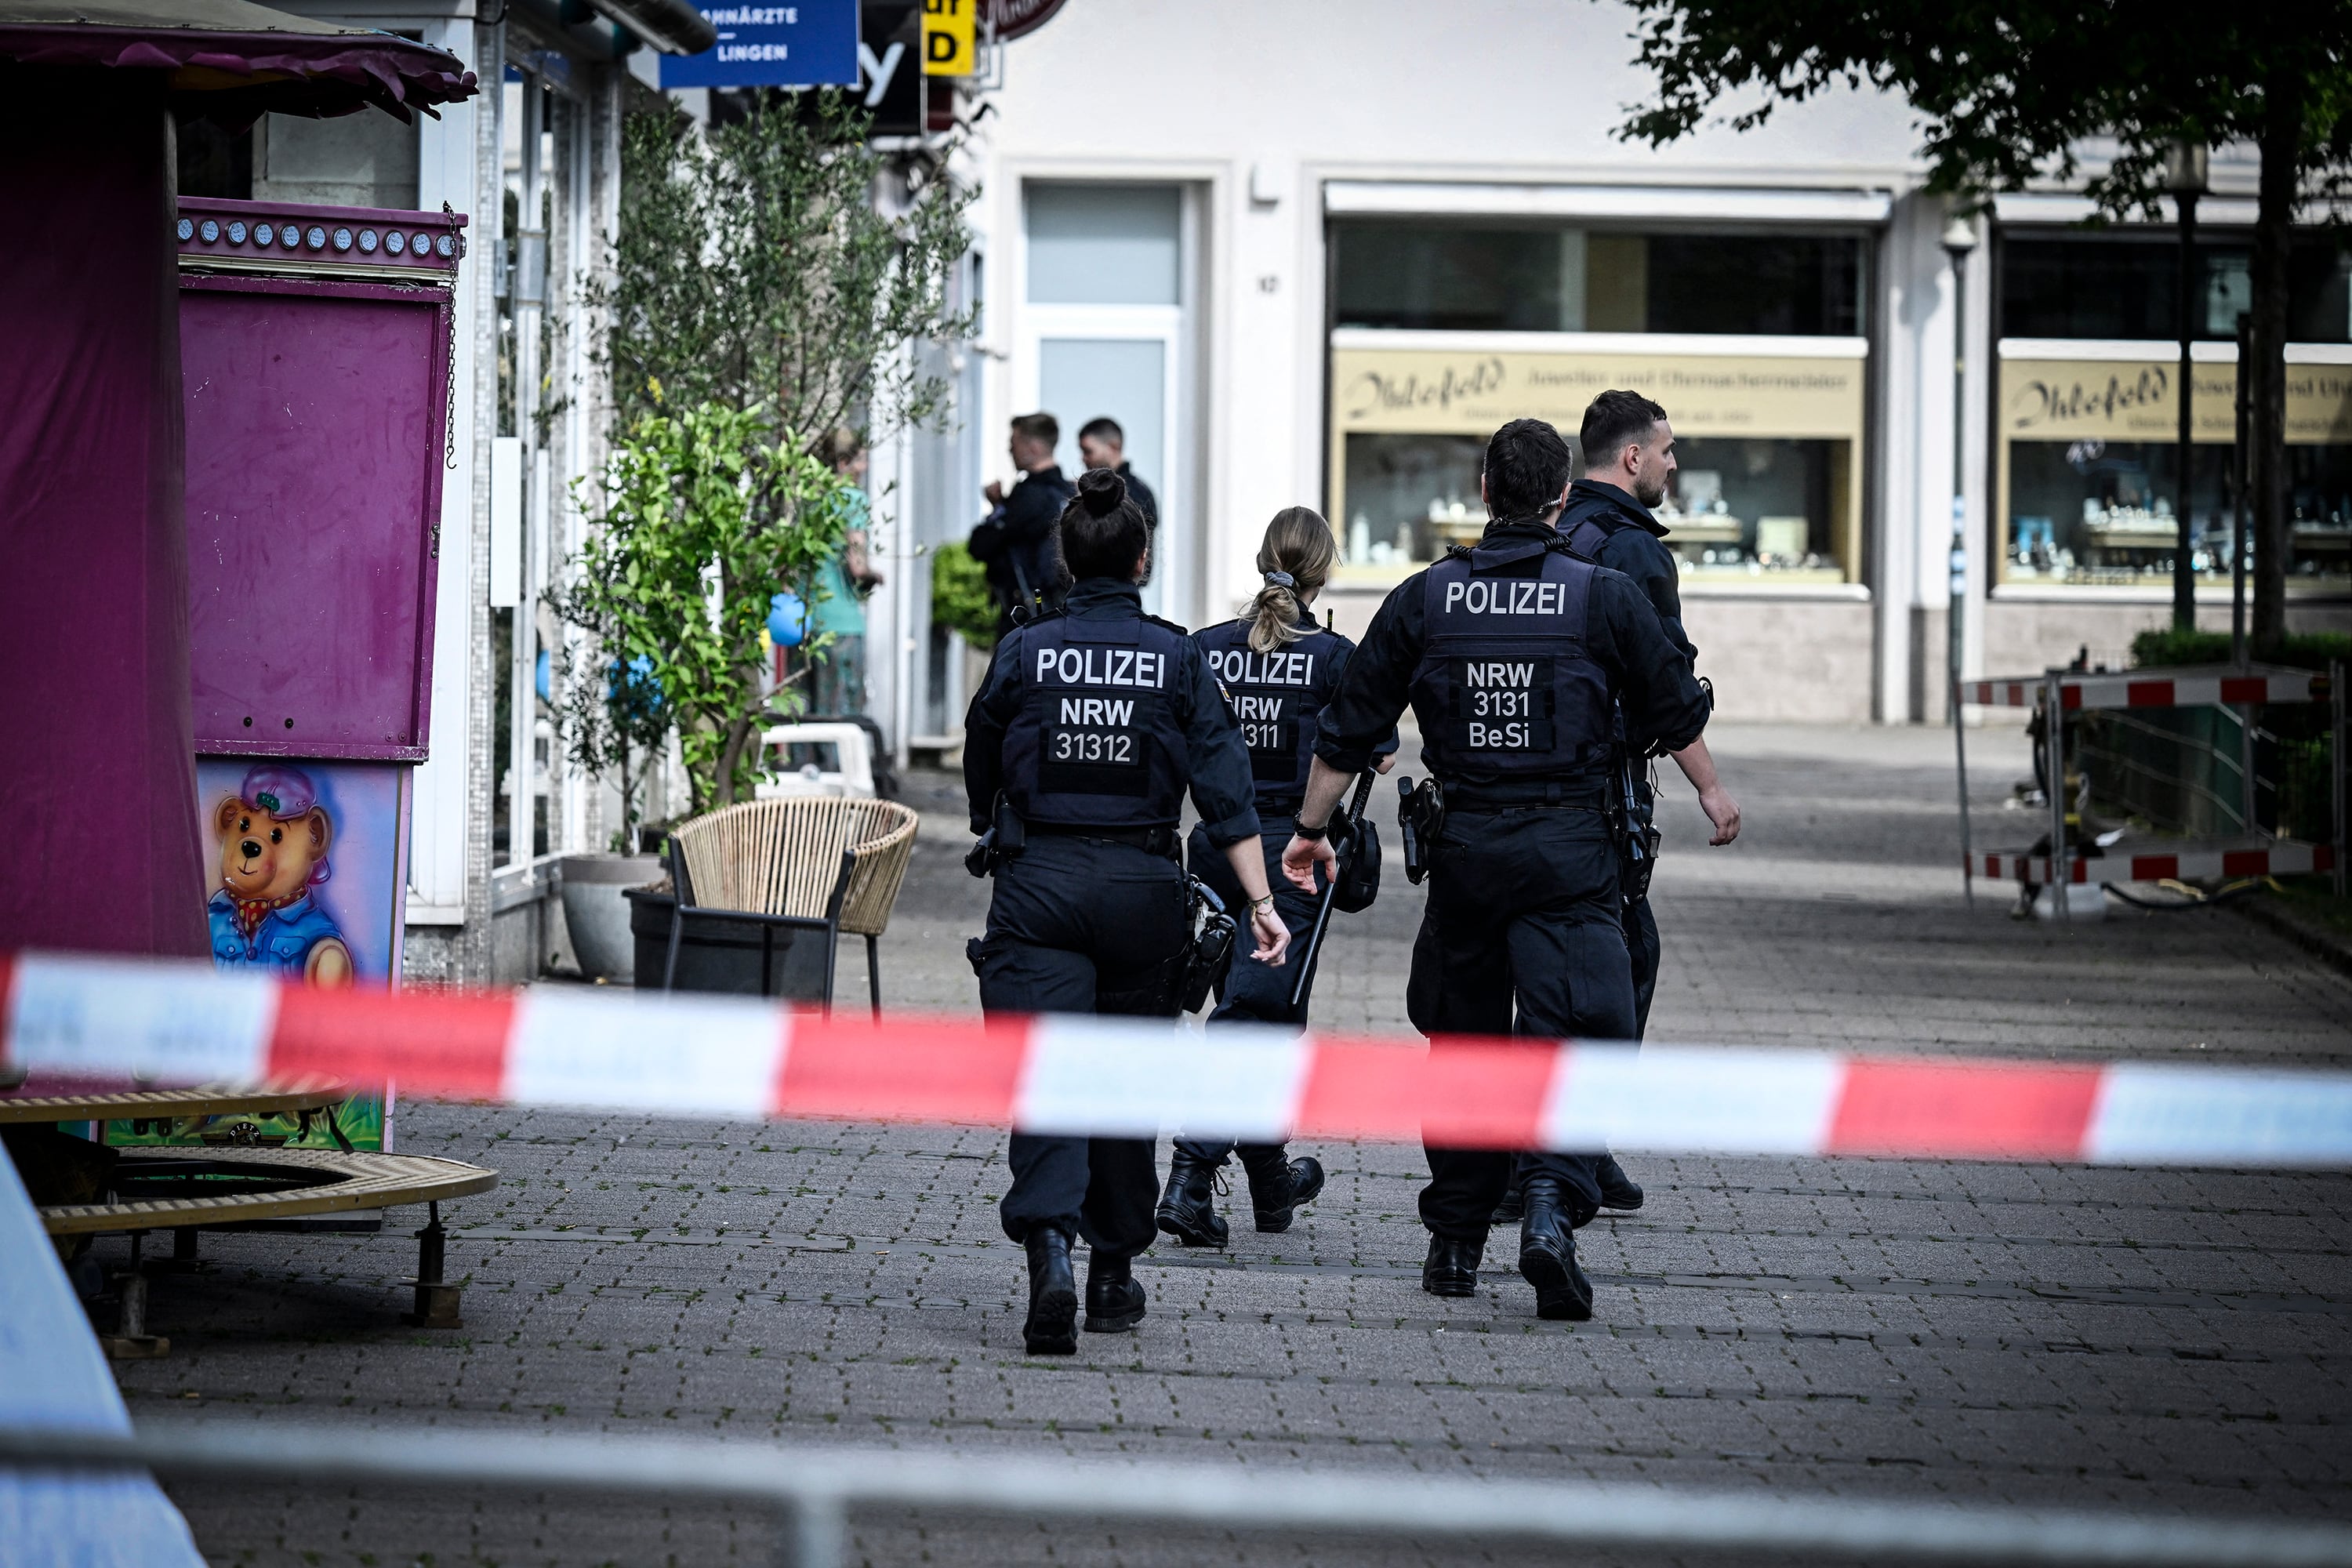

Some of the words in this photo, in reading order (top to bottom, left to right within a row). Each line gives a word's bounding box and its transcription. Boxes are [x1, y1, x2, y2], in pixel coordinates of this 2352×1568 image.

[699, 5, 798, 25] AHNÄRZTE
[717, 44, 788, 62] LINGEN
[1446, 581, 1566, 615] POLIZEI
[1036, 648, 1165, 688] POLIZEI
[1208, 649, 1314, 686] POLIZEI
[1468, 662, 1534, 688] NRW
[1061, 698, 1134, 727] NRW
[1474, 691, 1530, 717] 3131
[1055, 732, 1131, 762] 31312
[1469, 722, 1530, 747] BeSi
[230, 1123, 260, 1137] DIETZ
